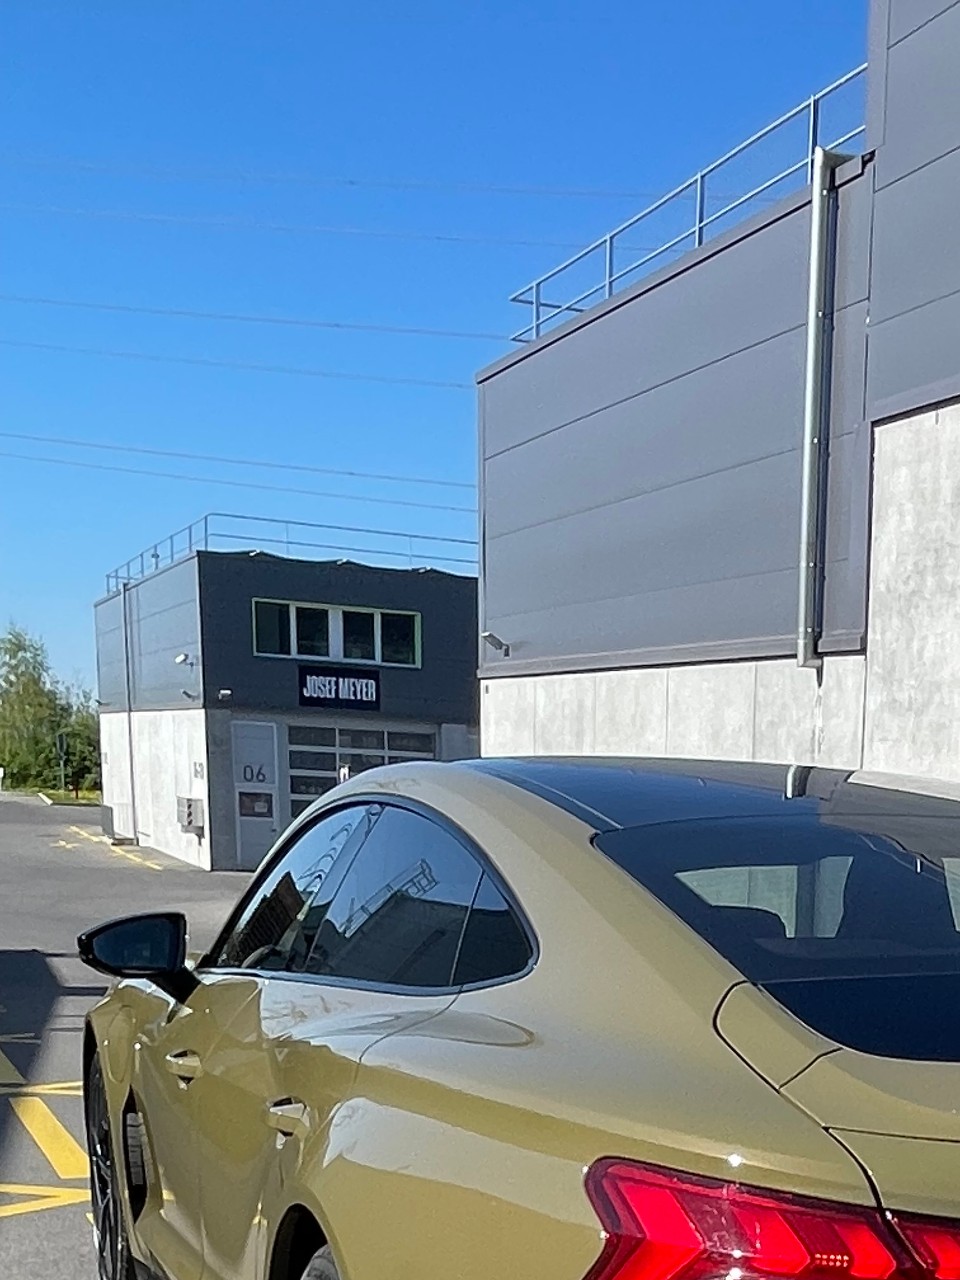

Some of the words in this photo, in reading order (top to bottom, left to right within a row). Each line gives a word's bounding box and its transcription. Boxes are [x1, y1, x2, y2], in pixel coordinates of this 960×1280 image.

[303, 675, 336, 699] JOSEF
[338, 677, 376, 701] MEYER
[243, 764, 266, 783] 06
